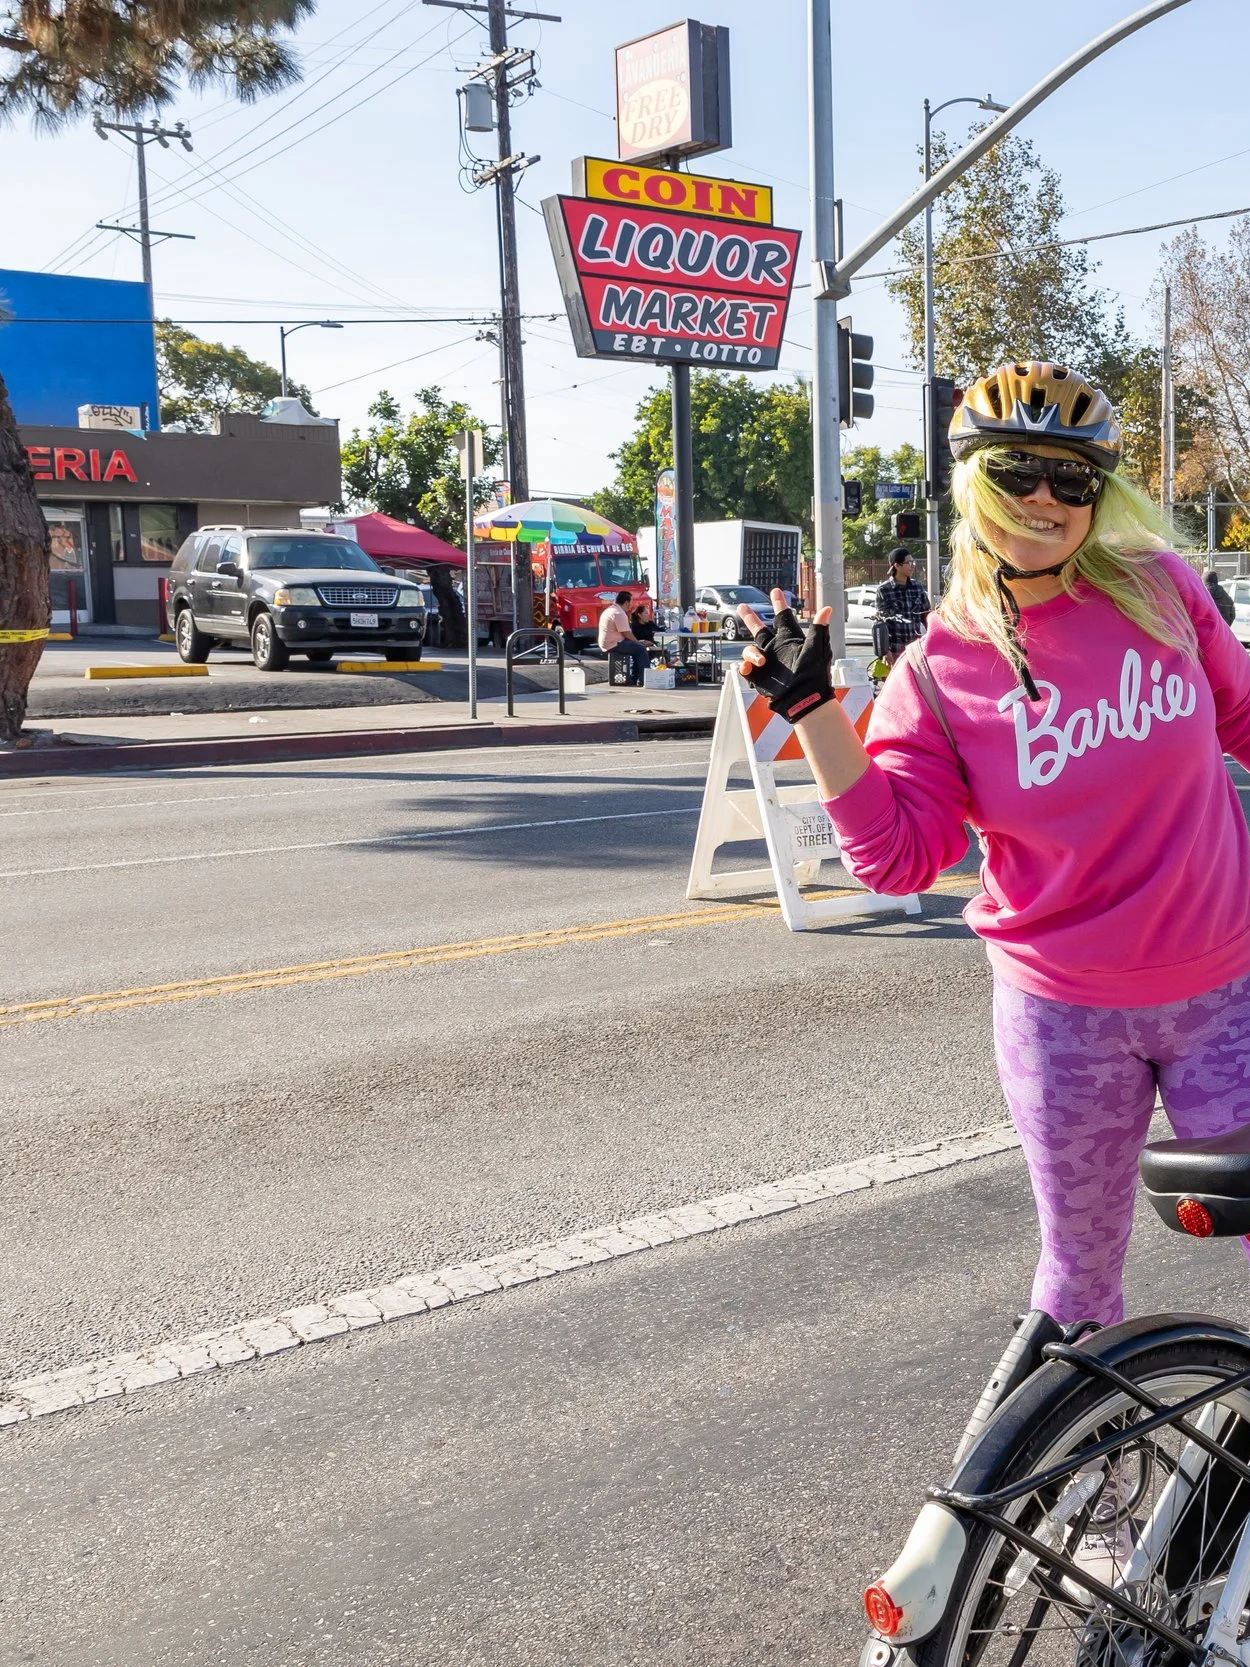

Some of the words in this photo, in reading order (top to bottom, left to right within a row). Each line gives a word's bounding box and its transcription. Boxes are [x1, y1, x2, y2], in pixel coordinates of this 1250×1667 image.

[624, 86, 680, 122] FREE
[632, 110, 677, 144] DRY
[602, 168, 758, 219] COIN
[579, 213, 792, 287] LIQUOR
[599, 284, 777, 343] MARKET
[613, 333, 662, 355] EBT
[689, 340, 762, 365] LOTTO
[553, 545, 575, 554] BIRRIA
[576, 545, 585, 553] DE
[586, 545, 605, 553] CHIVO
[621, 543, 633, 552] RES
[997, 648, 1197, 790] Barbie
[794, 824, 815, 835] DEPT.
[816, 823, 826, 833] OF
[802, 816, 815, 824] CITY
[817, 815, 826, 823] OF
[796, 832, 833, 847] STREET
